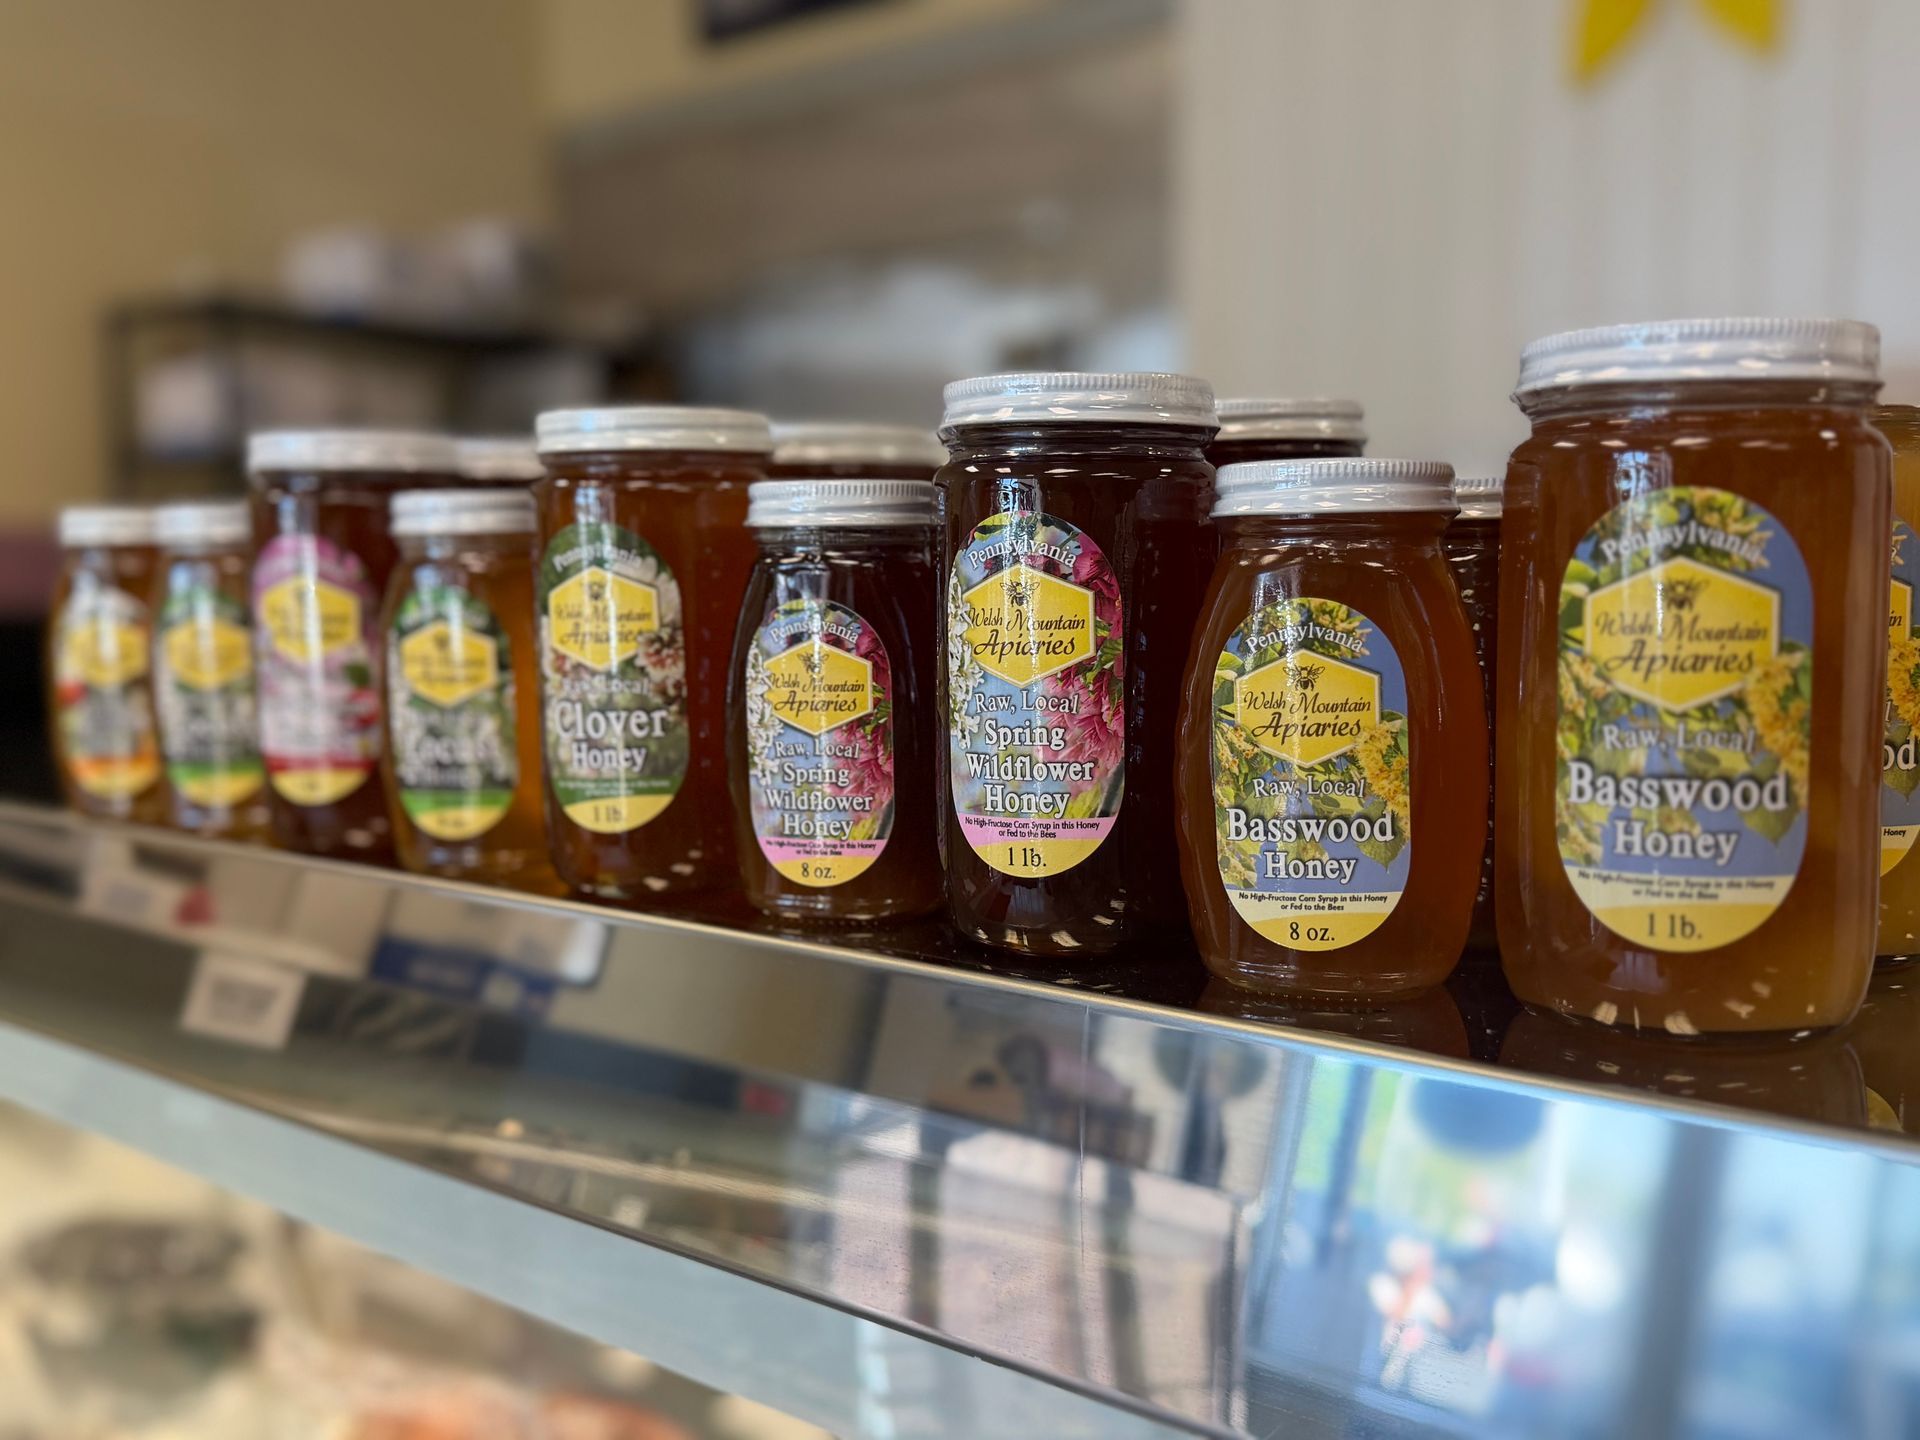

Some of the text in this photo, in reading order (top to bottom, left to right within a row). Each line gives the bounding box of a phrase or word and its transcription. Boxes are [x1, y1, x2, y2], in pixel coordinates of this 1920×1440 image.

[968, 536, 1078, 570] Pennsylvania
[1600, 520, 1763, 563] Pennsylvania
[769, 620, 860, 643] Pennsyvania
[968, 607, 1086, 632] Welsh Mountain
[1595, 611, 1769, 643] Welsh Mountain
[973, 628, 1076, 664] Apiaries
[1245, 622, 1364, 654] Pennsylvania
[1603, 638, 1755, 683] Apiaries
[769, 673, 800, 689] Welsh
[773, 690, 858, 718] Apiaries
[974, 690, 1080, 715] Raw, Local
[1243, 690, 1371, 715] Welsh Mountain
[554, 700, 669, 739] Clover
[1250, 711, 1362, 746] Apiaries
[775, 738, 860, 759] Raw, Local
[984, 719, 1066, 751] Spring
[1602, 722, 1757, 752] Raw, Local
[572, 741, 647, 773] Honey
[965, 752, 1096, 782] Wildflower
[782, 762, 850, 787] Spring
[1252, 775, 1366, 799] Raw, Local
[1567, 760, 1788, 812] Basswood
[765, 788, 874, 811] Wildflower
[983, 783, 1071, 819] Honey
[782, 813, 854, 841] Honey
[965, 816, 1101, 832] No High-Fructose Corn Syrup in this Honey
[1006, 829, 1018, 838] Fed
[1019, 829, 1026, 838] to
[1027, 829, 1039, 839] the
[1040, 831, 1057, 839] Bees
[1225, 807, 1396, 843] Basswood
[1883, 828, 1907, 838] Honey
[1007, 846, 1047, 868] 1 lb.
[1613, 819, 1739, 867] Honey
[801, 862, 837, 879] 8 oz.
[1263, 850, 1358, 885] Honey
[1238, 891, 1388, 904] No High-Fructose Corn Syrup in this Honey
[1290, 903, 1303, 911] Fed
[1313, 903, 1326, 911] the
[1327, 903, 1345, 911] Bees
[1289, 921, 1336, 942] 8 oz.
[1647, 912, 1703, 940] 1 lb.
